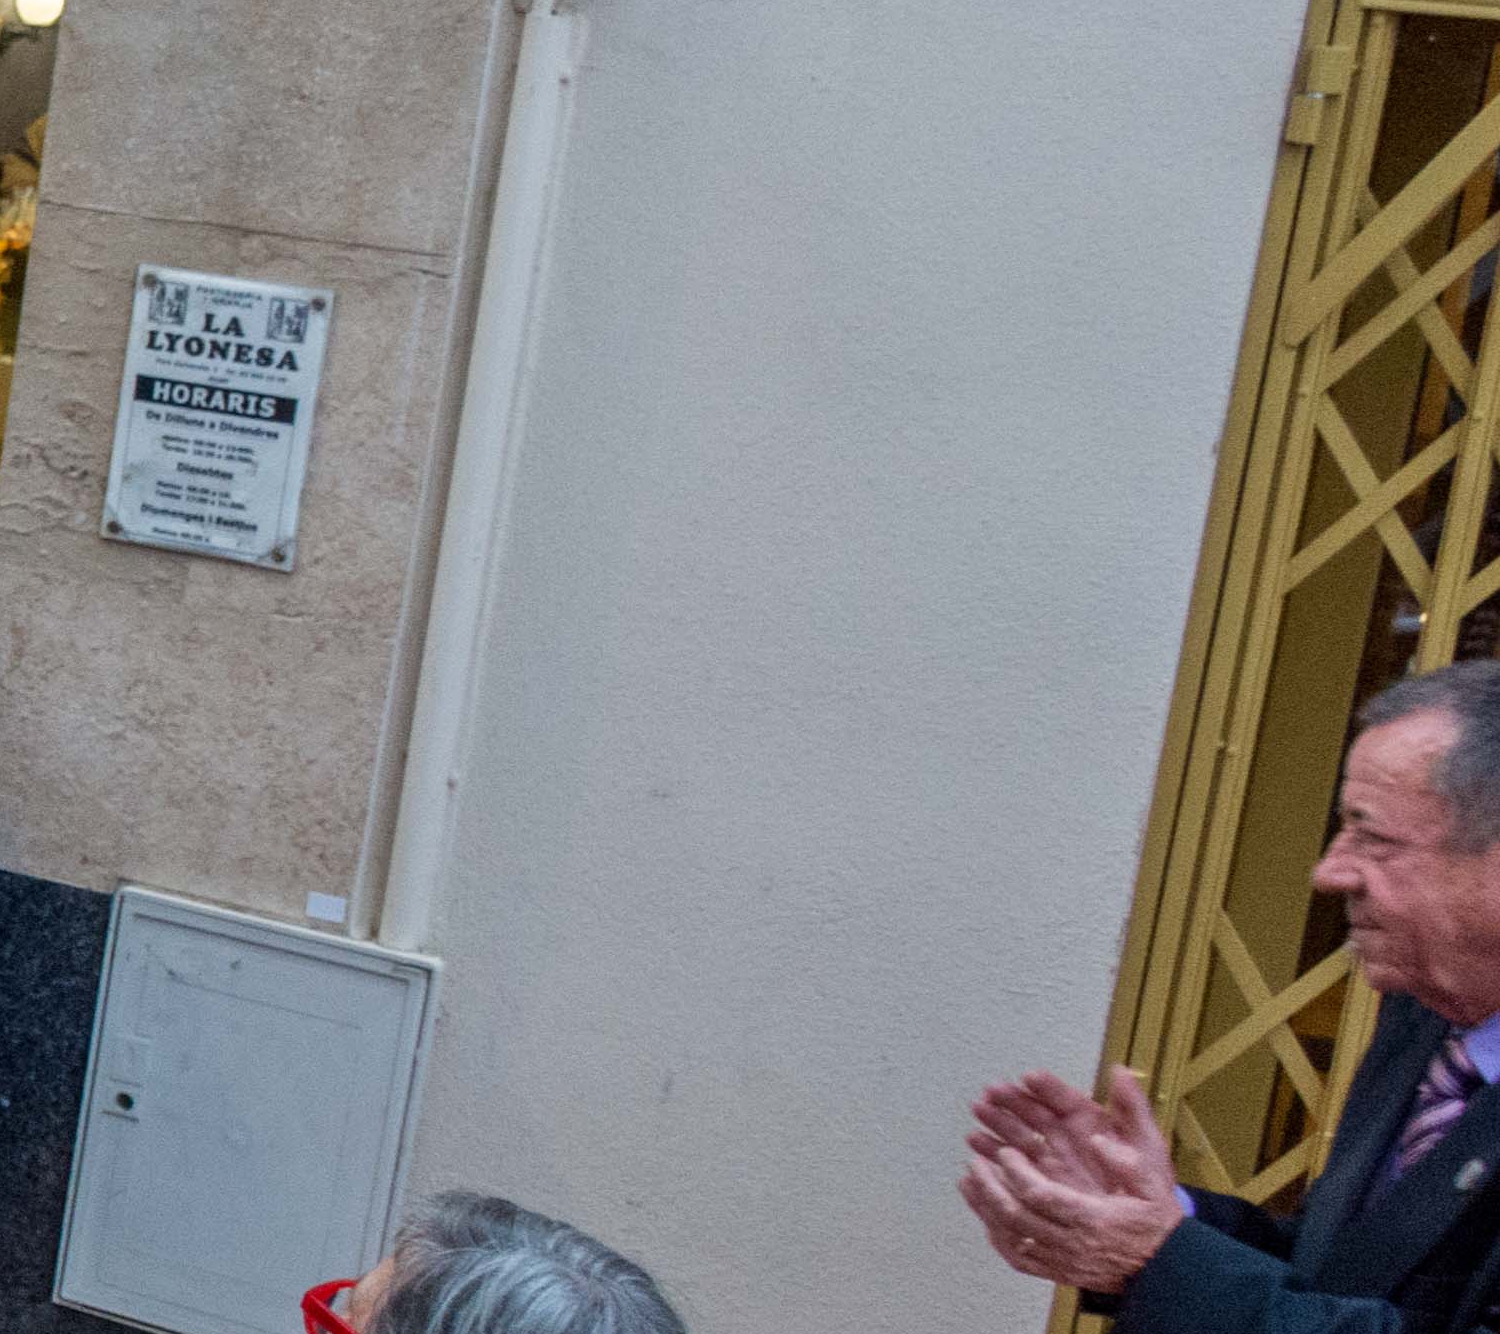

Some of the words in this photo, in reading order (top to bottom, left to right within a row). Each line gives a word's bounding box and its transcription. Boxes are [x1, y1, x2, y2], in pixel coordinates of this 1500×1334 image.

[202, 312, 247, 338] LA
[146, 329, 299, 371] LYONESA
[153, 381, 277, 419] HORARIS
